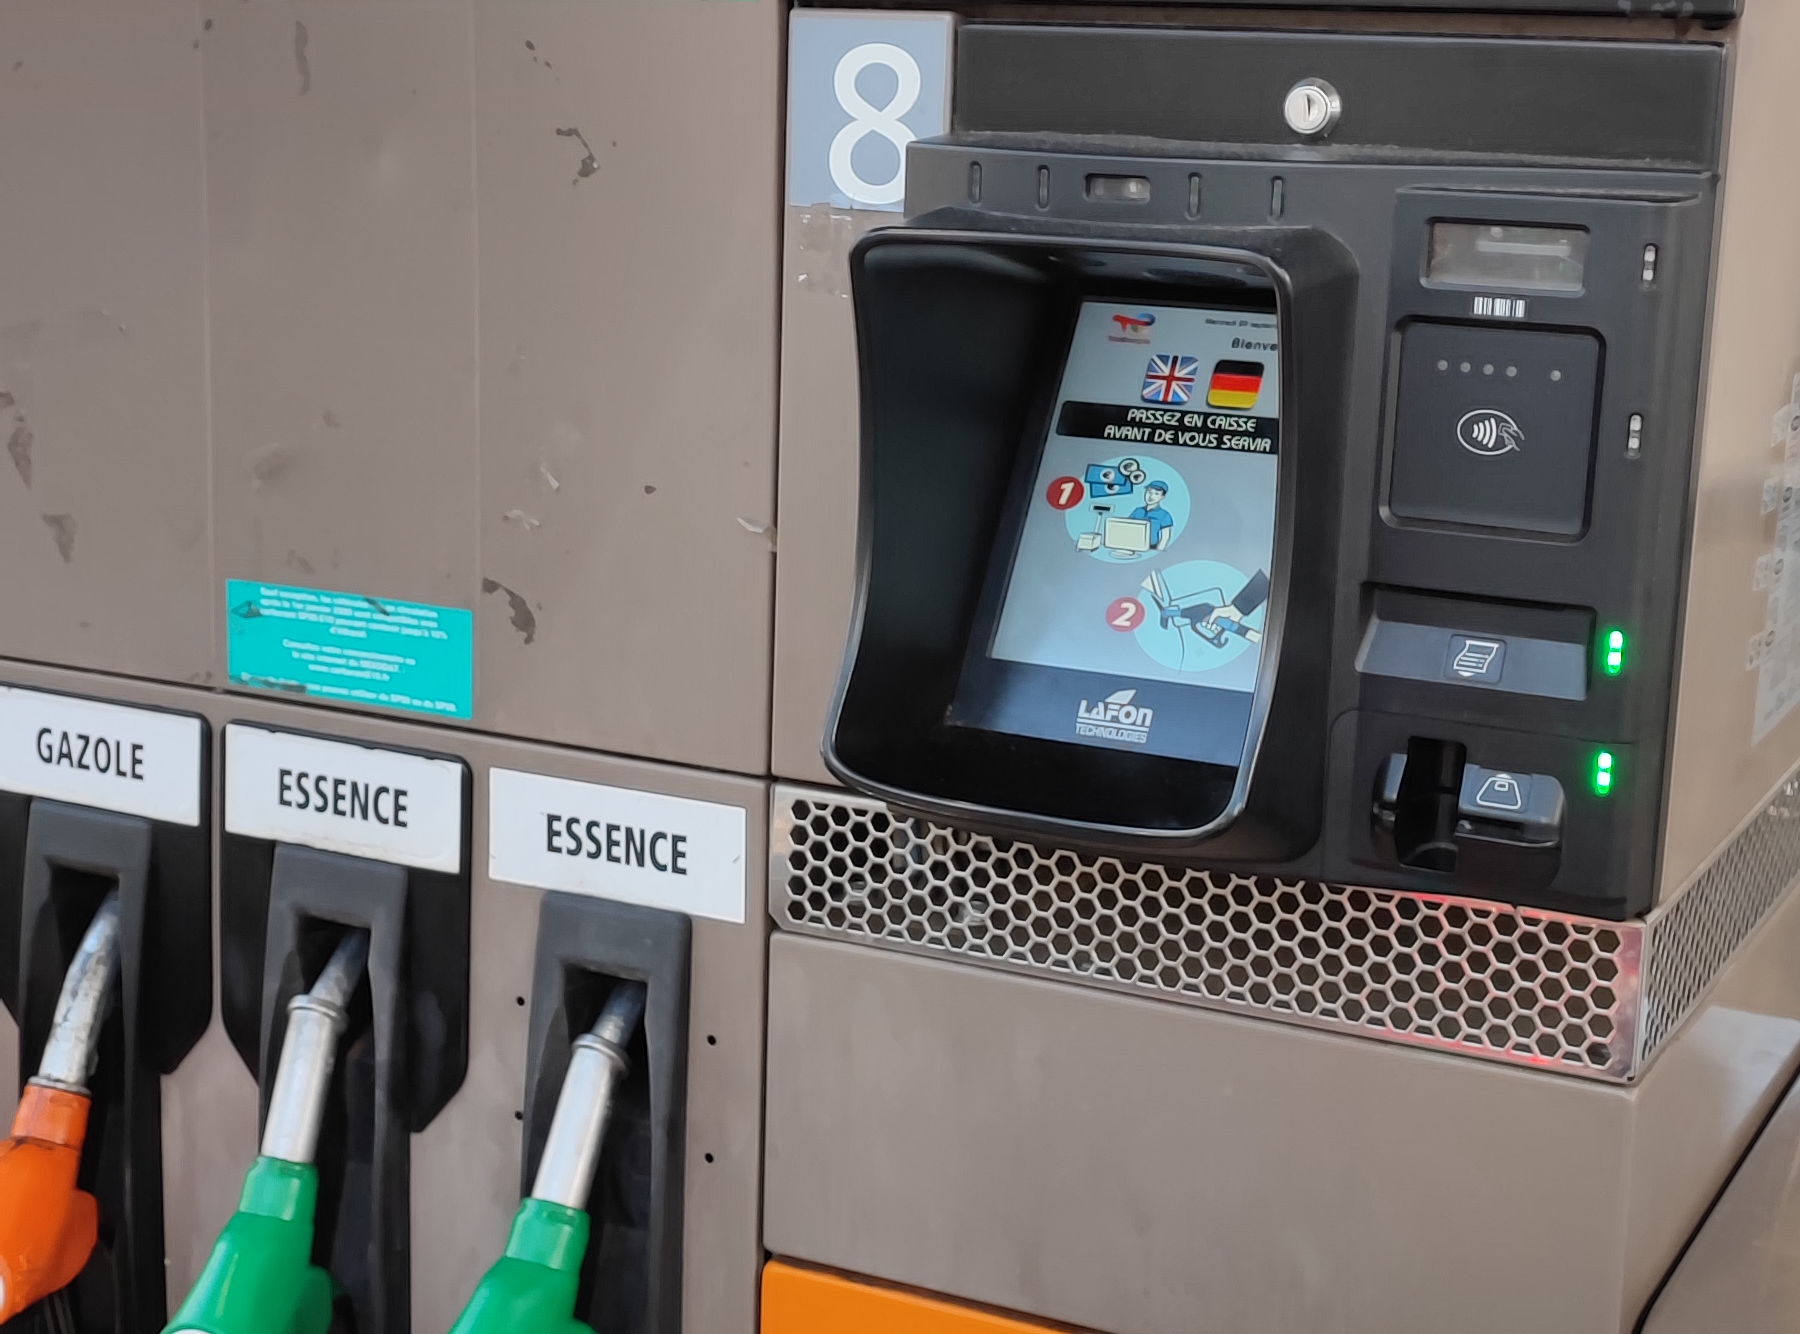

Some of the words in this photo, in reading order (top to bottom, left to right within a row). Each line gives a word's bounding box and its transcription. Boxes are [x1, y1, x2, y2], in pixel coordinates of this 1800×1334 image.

[829, 43, 921, 204] 8
[1127, 408, 1181, 426] PASSEZ
[1184, 412, 1203, 428] EN
[1207, 415, 1257, 432] CAISSE
[1103, 425, 1152, 441] AVANT
[1154, 429, 1175, 443] DE
[1178, 431, 1218, 447] VOUS
[1221, 435, 1272, 452] SERVIR
[1058, 482, 1075, 505] 1
[1111, 602, 1136, 626] 2
[1078, 699, 1154, 727] LAFON
[37, 727, 144, 781] GAZOLE
[278, 768, 408, 828] ESSENCE
[547, 813, 688, 875] ESSENCE
